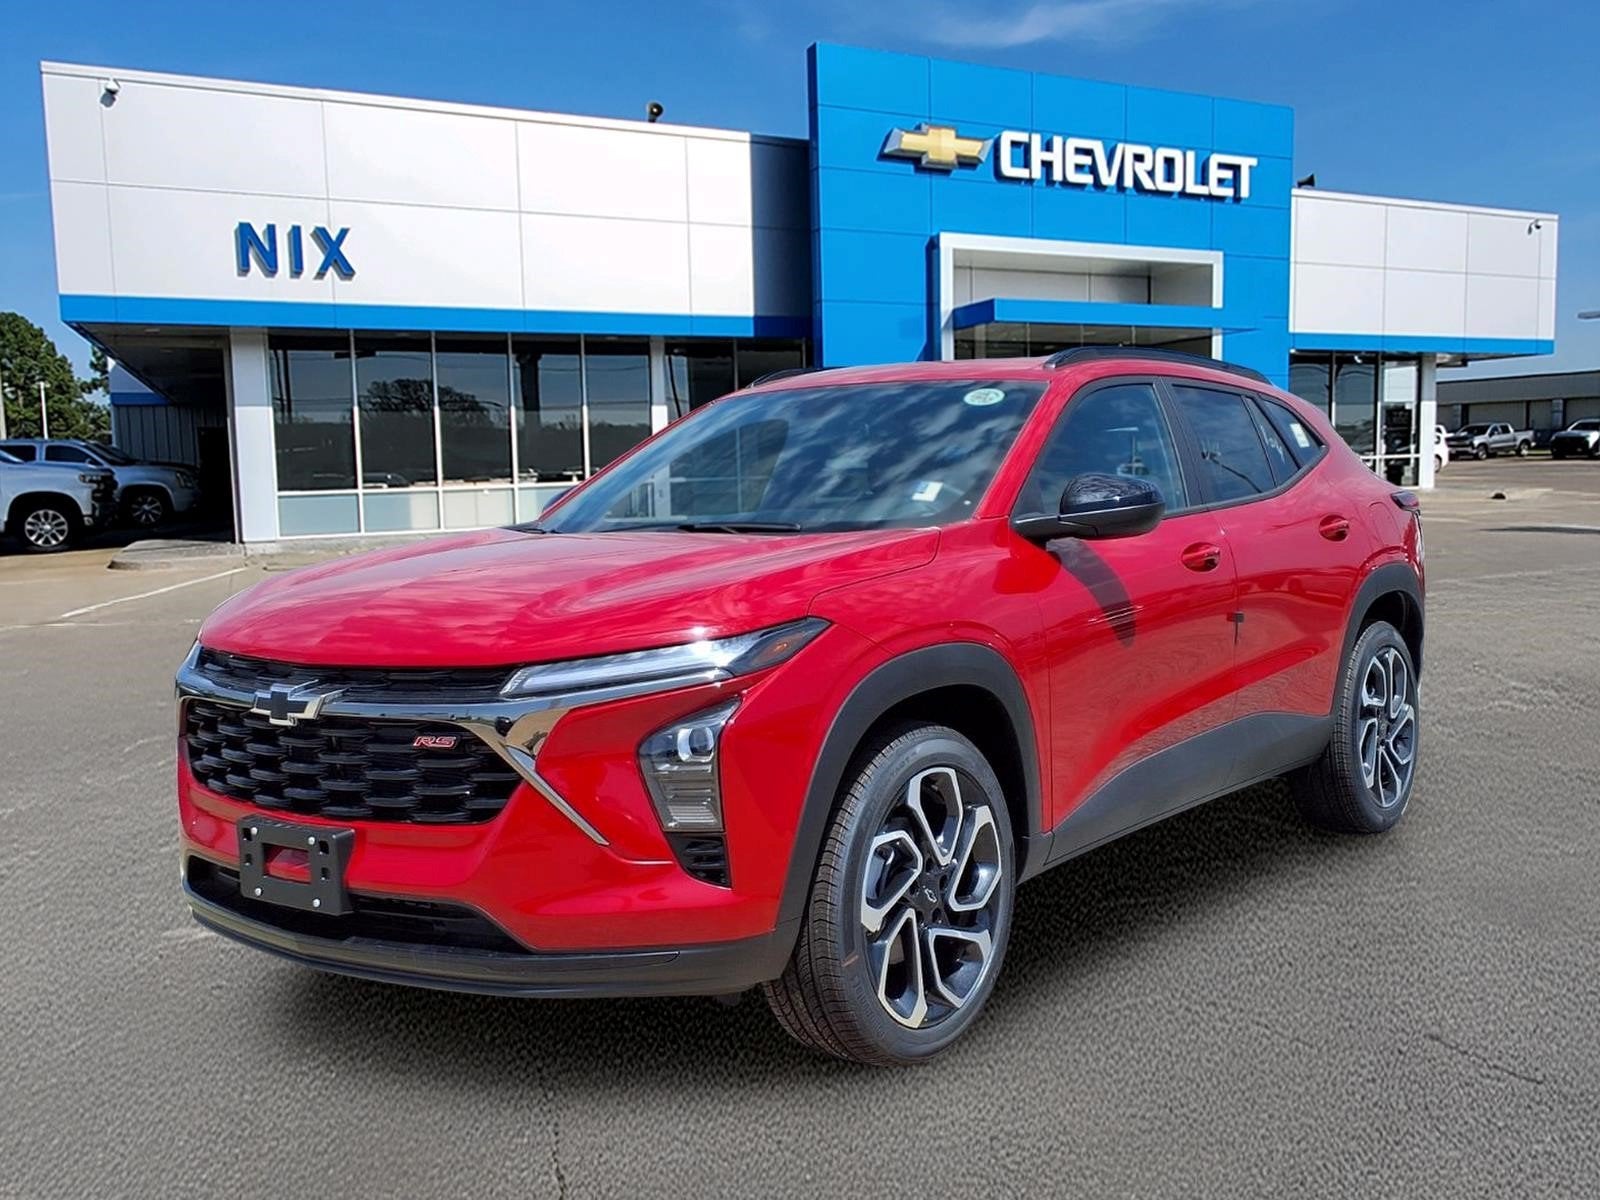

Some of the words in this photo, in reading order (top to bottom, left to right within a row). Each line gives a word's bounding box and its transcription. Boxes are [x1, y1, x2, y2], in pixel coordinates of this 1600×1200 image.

[998, 129, 1258, 199] CHEVROLET
[235, 221, 356, 281] NIX
[412, 735, 457, 749] RS
